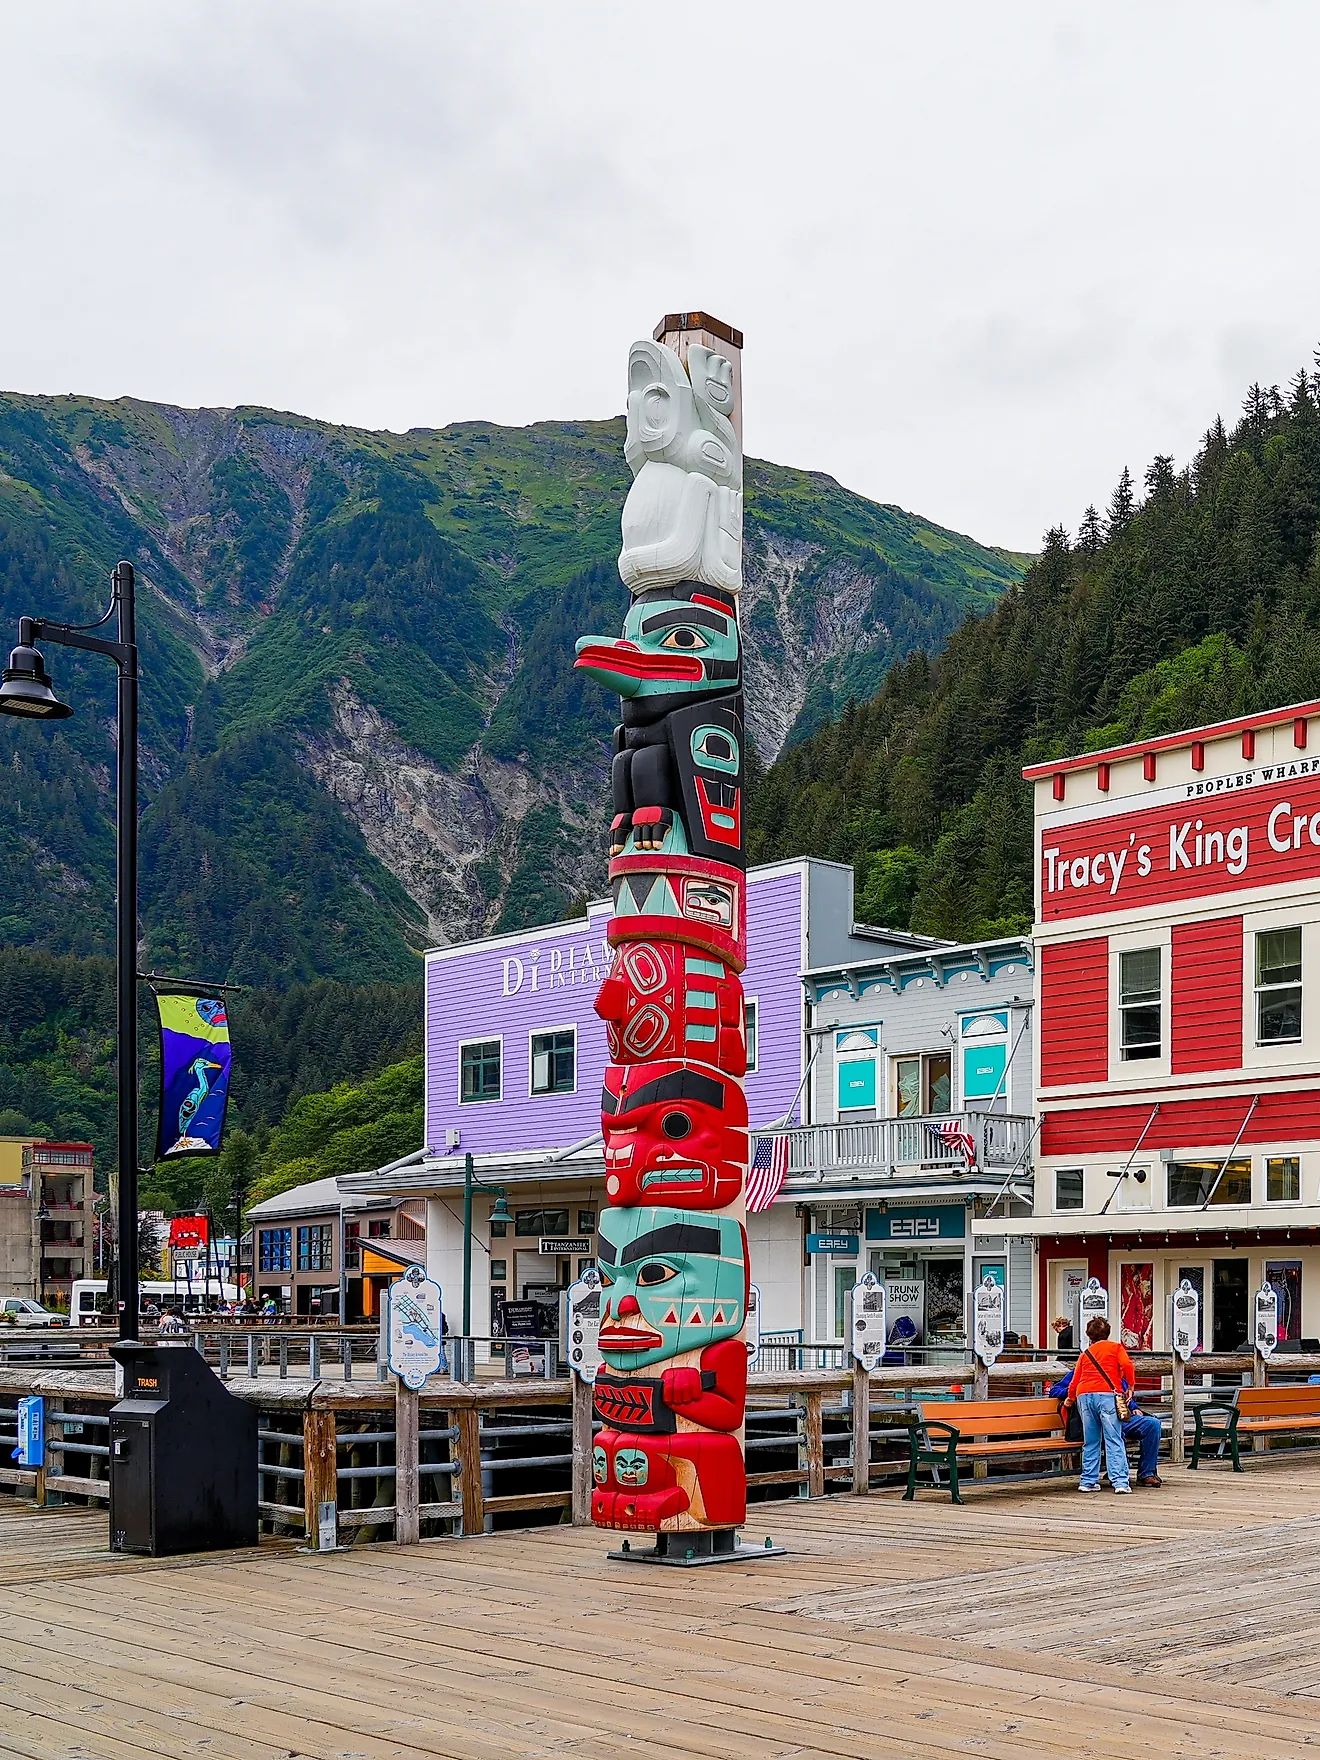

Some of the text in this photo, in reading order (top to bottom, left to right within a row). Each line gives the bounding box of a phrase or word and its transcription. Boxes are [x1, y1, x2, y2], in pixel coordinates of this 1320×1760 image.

[1187, 760, 1320, 797] PEOPLES' WHARF
[1043, 832, 1152, 896] Tracy's
[1169, 819, 1249, 875] King
[890, 1218, 940, 1236] EFFY
[818, 1239, 849, 1249] EFFY
[889, 1285, 920, 1294] TRUNK
[889, 1293, 919, 1303] SHOW
[137, 1378, 158, 1387] TRASH
